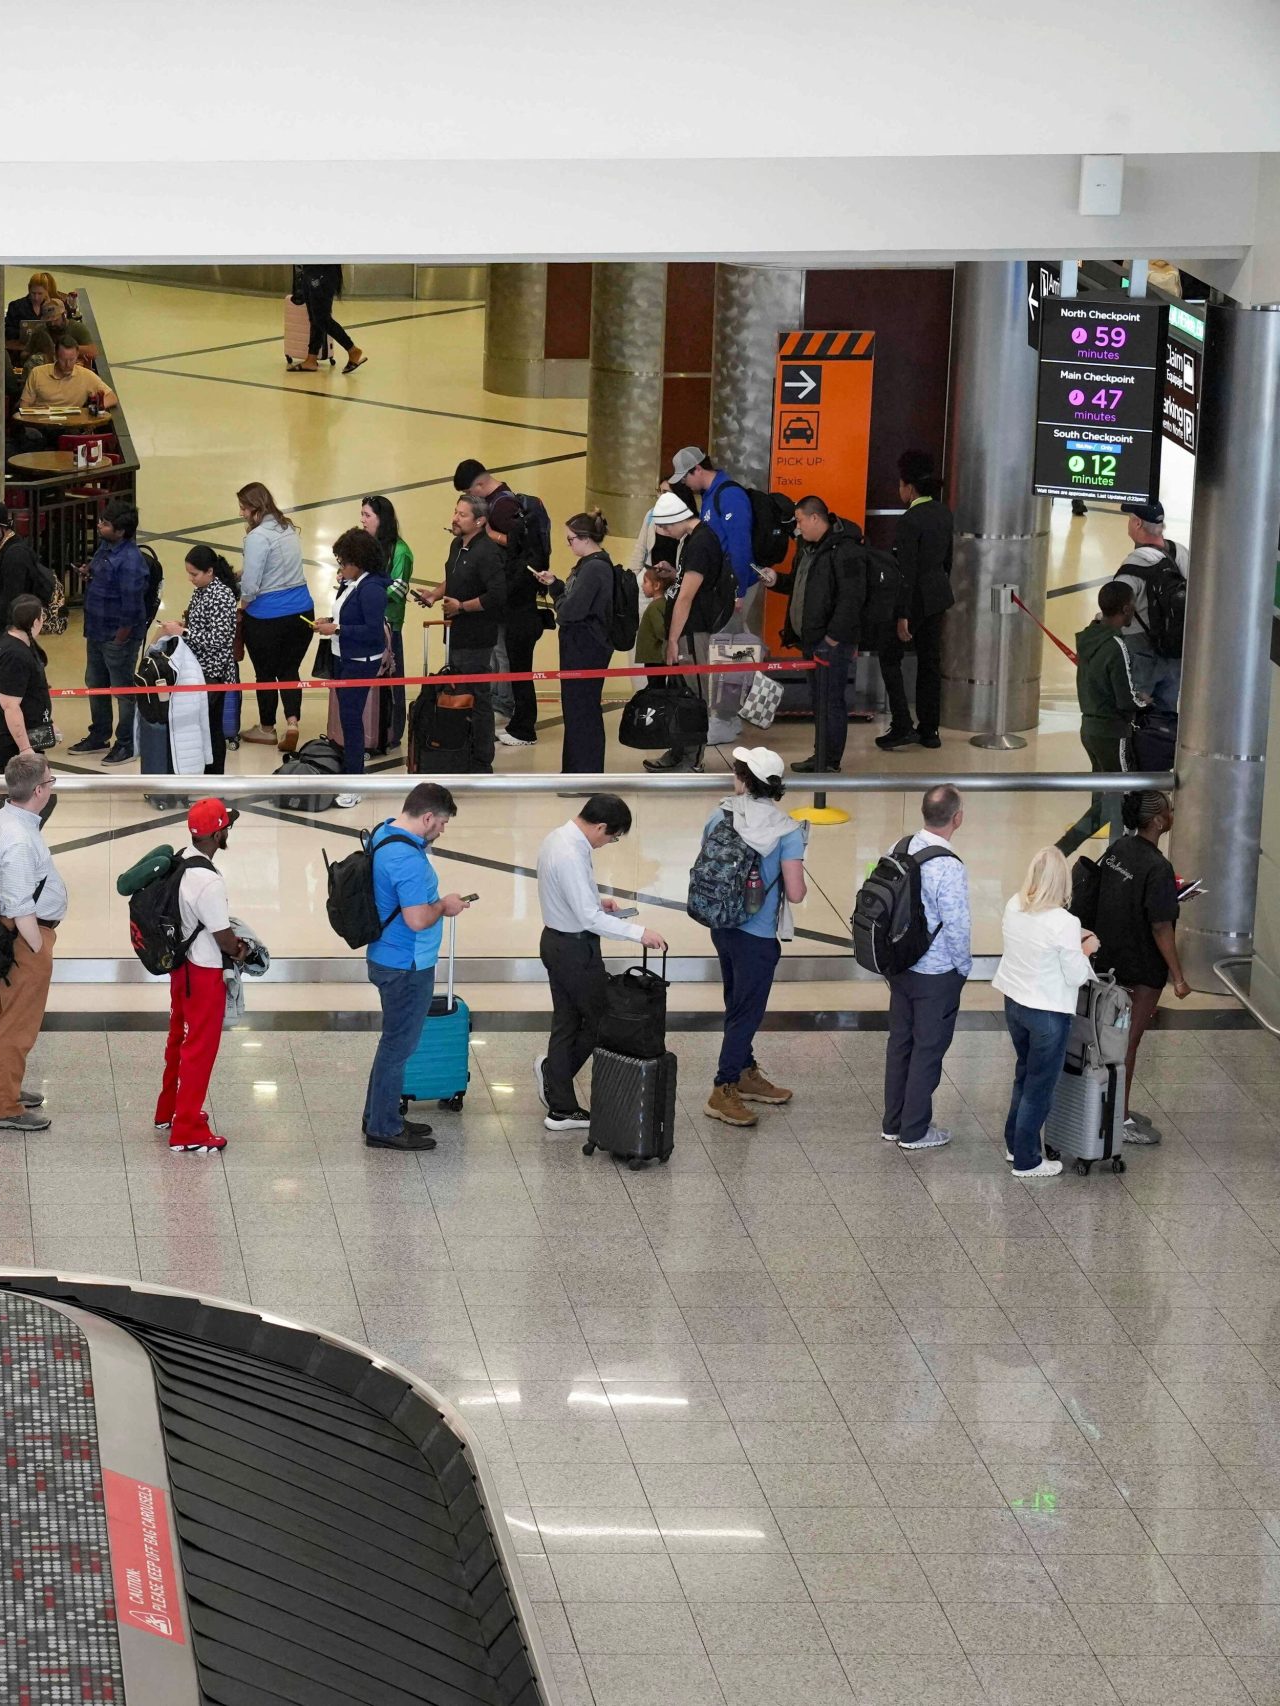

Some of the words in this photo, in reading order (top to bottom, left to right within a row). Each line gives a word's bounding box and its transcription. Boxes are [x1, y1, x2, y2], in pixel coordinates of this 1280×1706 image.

[1061, 308, 1087, 318] North
[1089, 310, 1140, 322] Checkpoint
[1095, 326, 1126, 348] 59
[1078, 349, 1120, 360] minutes
[1060, 370, 1081, 380] Main
[1084, 372, 1135, 384] Checkpoint
[1092, 389, 1123, 410] 47
[1074, 410, 1117, 422] minutes
[1162, 396, 1184, 427] arking
[1054, 429, 1080, 439] South
[1082, 432, 1134, 444] Checkpoint
[776, 456, 803, 466] PICK
[1092, 454, 1116, 476] 12
[776, 476, 802, 486] Taxis
[1072, 474, 1114, 486] minutes
[138, 1485, 156, 1529] CAROUSELS
[143, 1528, 158, 1546] BAG
[144, 1544, 160, 1562] OFF
[146, 1560, 163, 1583] KEEP
[149, 1580, 167, 1614] PLEASE
